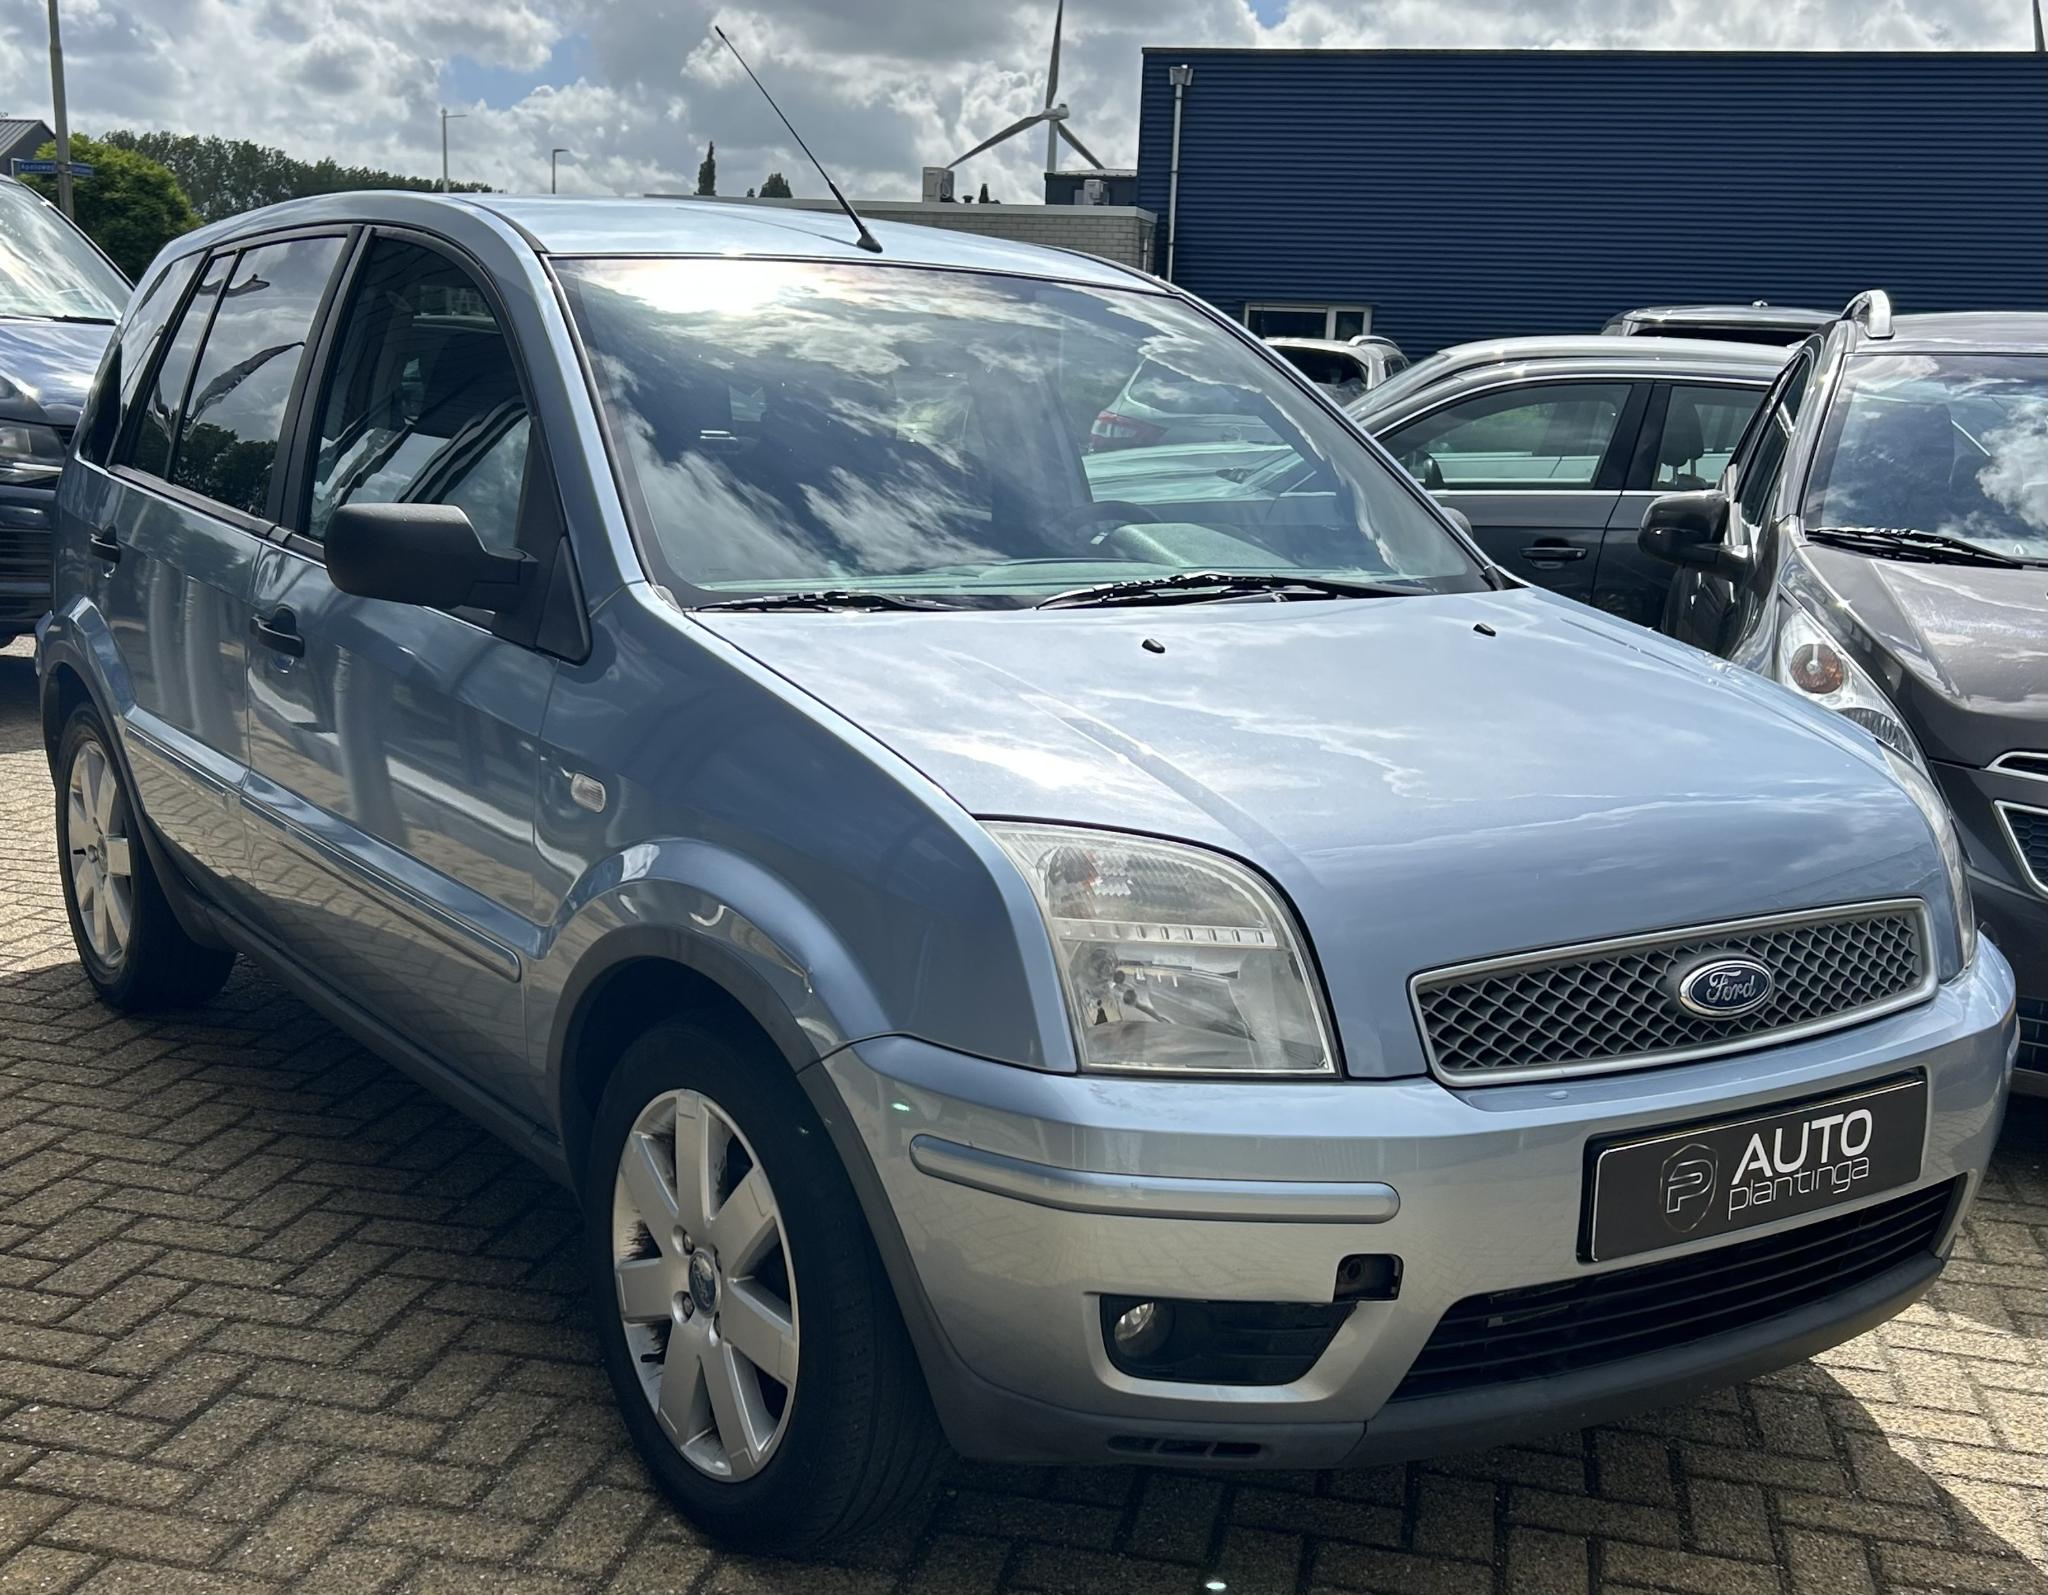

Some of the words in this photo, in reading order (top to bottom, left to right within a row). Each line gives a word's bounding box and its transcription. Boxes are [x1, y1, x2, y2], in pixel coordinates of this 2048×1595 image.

[1706, 970, 1756, 1003] Ford
[1731, 1109, 1873, 1185] AUTO
[1728, 1157, 1869, 1221] plantinga
